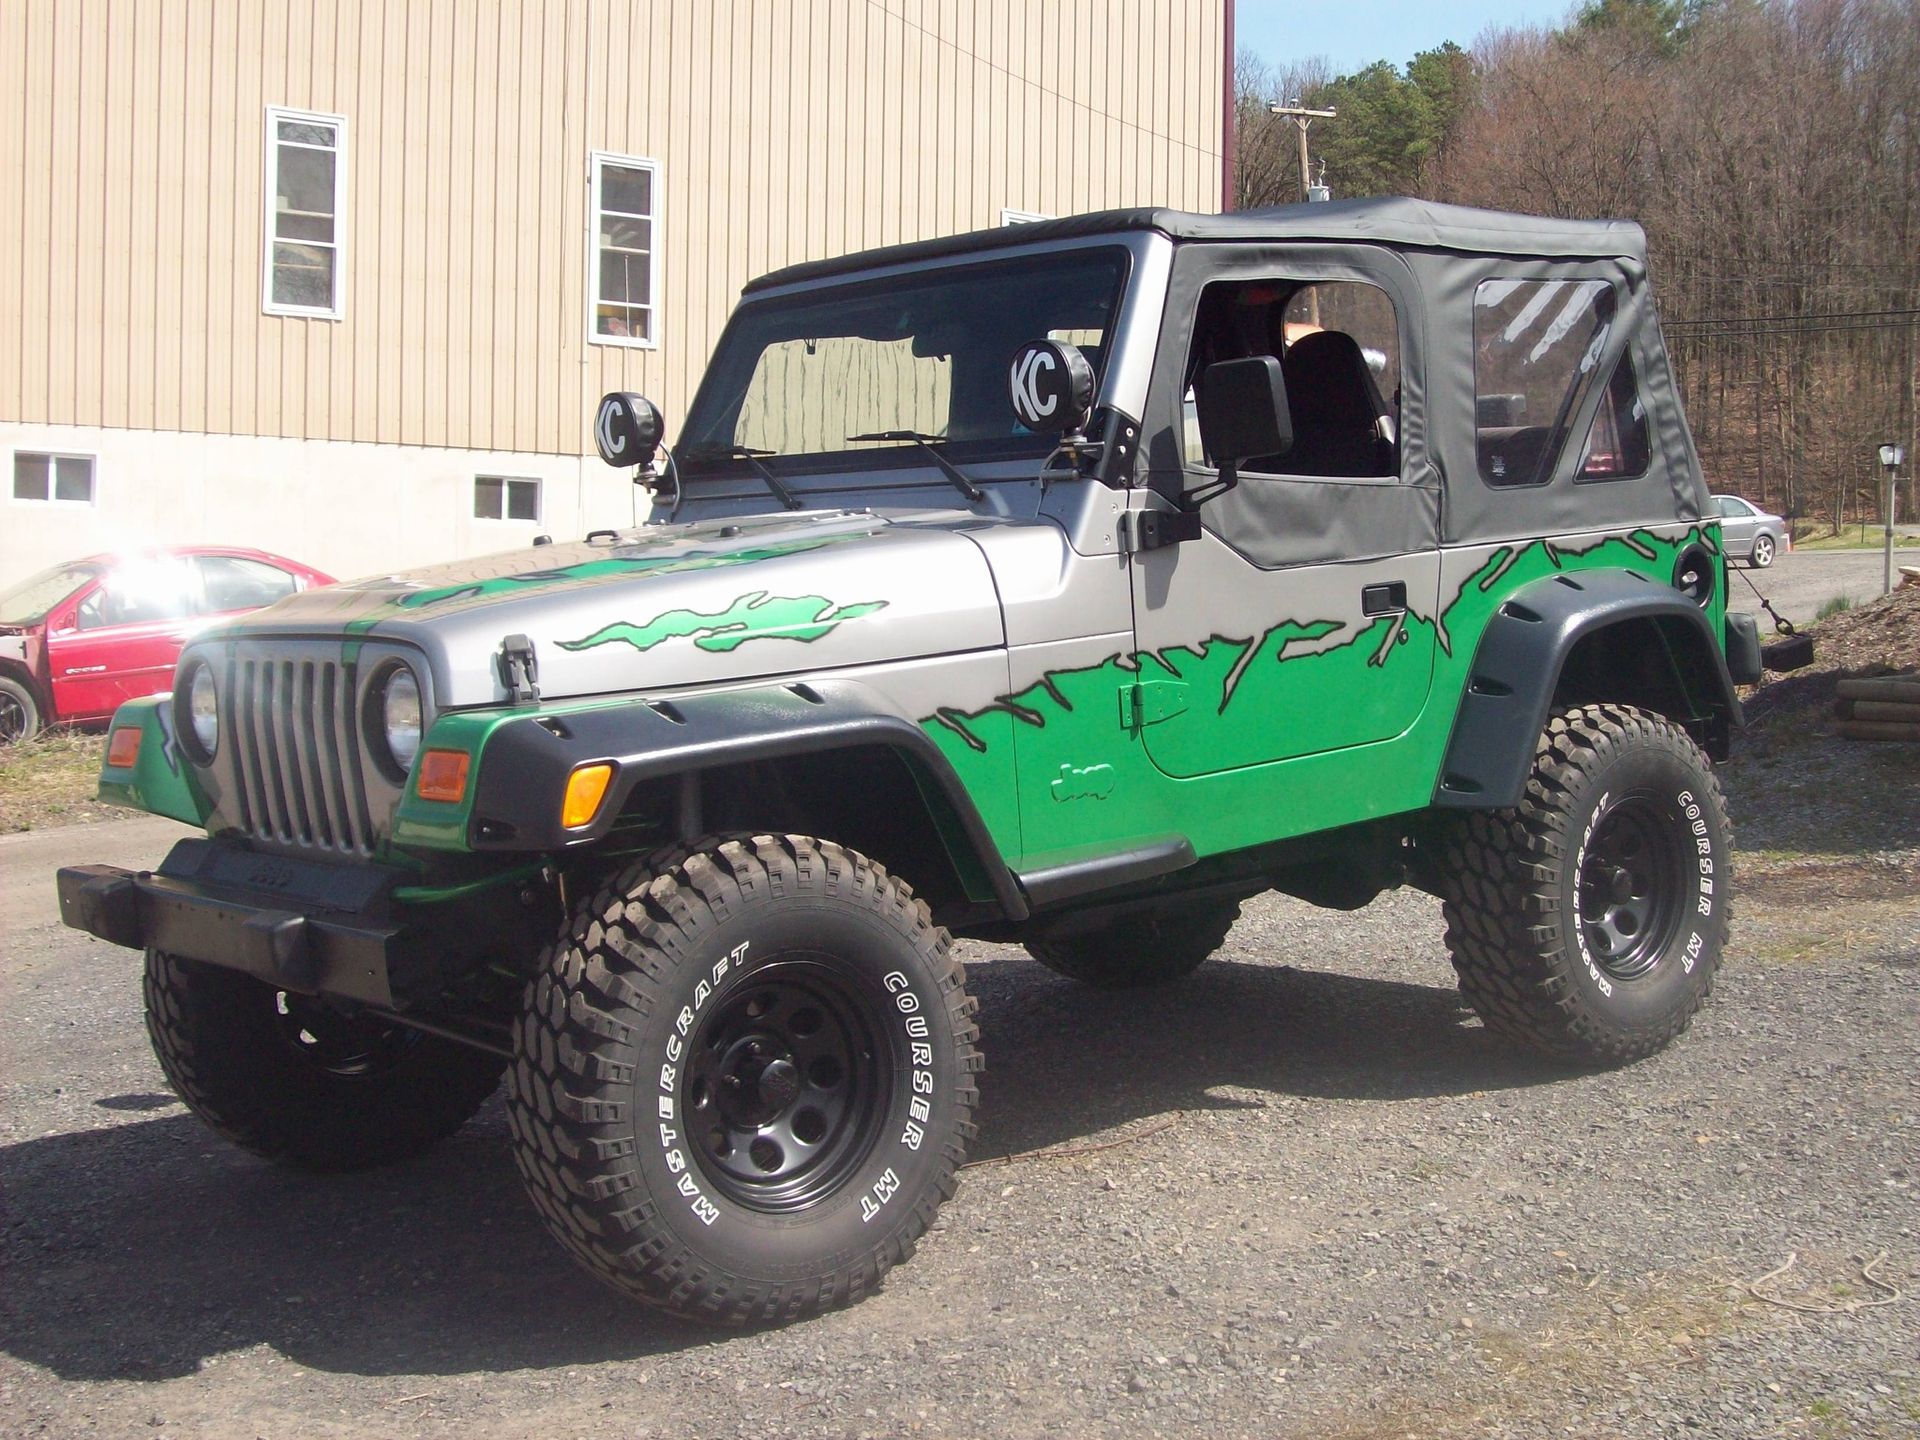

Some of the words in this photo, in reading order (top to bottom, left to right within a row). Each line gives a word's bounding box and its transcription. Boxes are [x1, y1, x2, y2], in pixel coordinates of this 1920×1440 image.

[1011, 349, 1058, 422] KC
[1573, 791, 1612, 998] MASTERCRAFT
[1677, 790, 1713, 916] COURSER
[1680, 931, 1703, 974] MT
[659, 941, 749, 1226] MASTERCRAFT
[883, 971, 933, 1151] COURSER
[861, 1168, 901, 1222] MT
